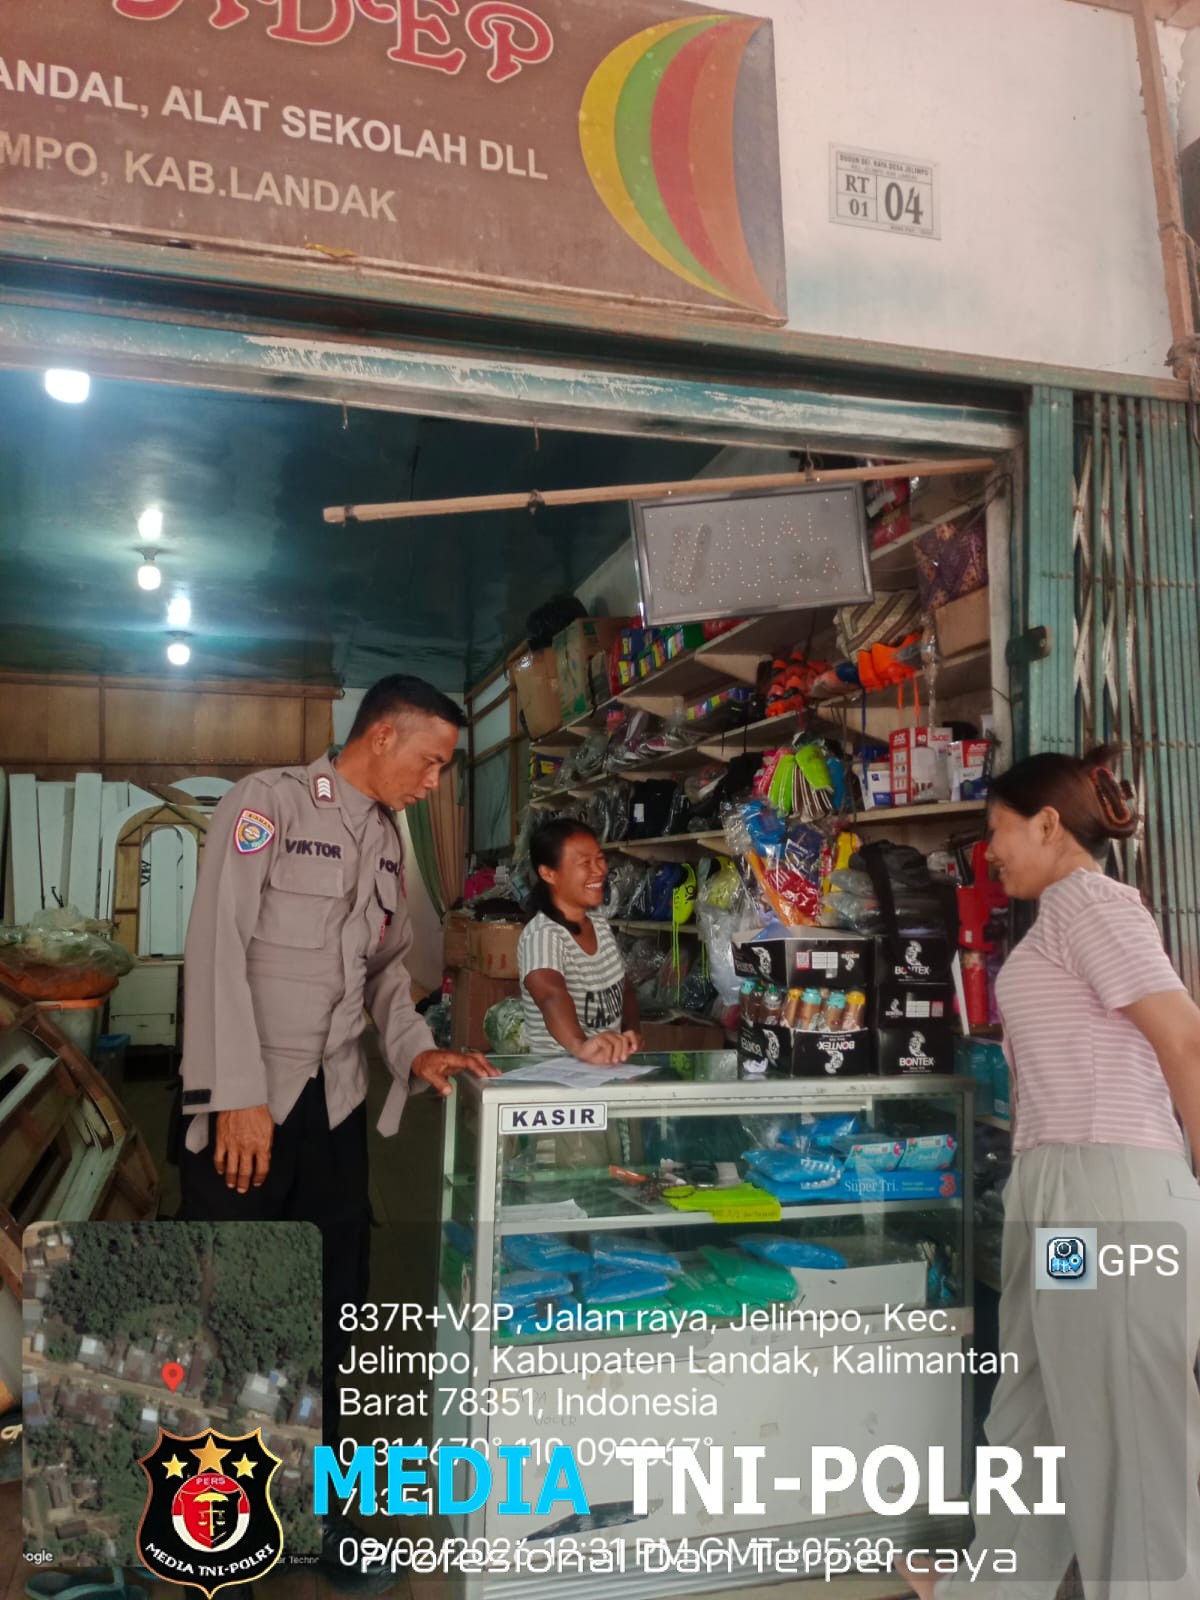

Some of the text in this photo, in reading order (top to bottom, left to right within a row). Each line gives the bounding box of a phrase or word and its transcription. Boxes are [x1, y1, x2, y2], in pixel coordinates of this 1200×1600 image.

[161, 85, 269, 132] ALAT
[281, 105, 467, 166] SEKOLAH
[480, 134, 548, 180] DLL
[125, 149, 398, 222] KAB.LANDAK
[845, 174, 870, 194] RT
[849, 198, 868, 217] 01
[884, 182, 924, 225] 04
[285, 838, 342, 860] VIKTOR
[894, 965, 931, 975] BOTEX
[817, 1041, 855, 1050] BONTEX
[898, 1057, 935, 1067] BONTEX
[512, 1108, 595, 1127] KASIR
